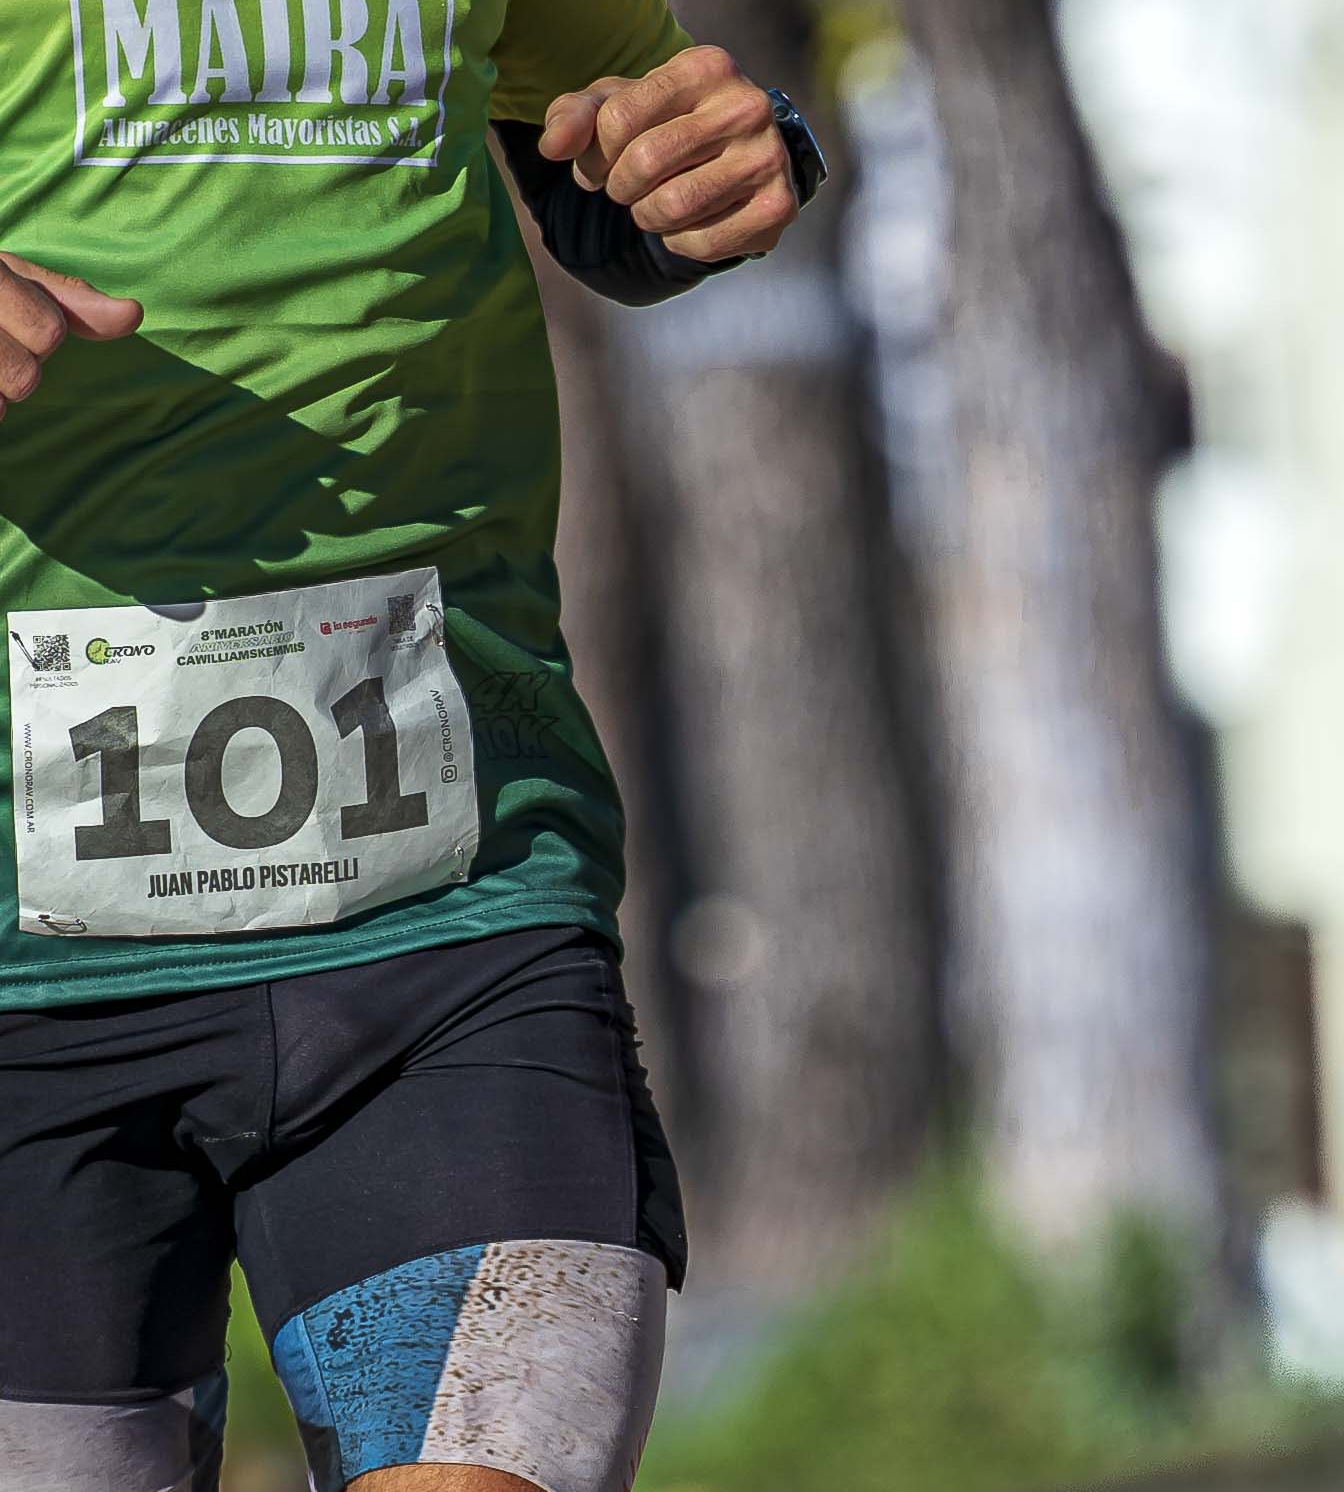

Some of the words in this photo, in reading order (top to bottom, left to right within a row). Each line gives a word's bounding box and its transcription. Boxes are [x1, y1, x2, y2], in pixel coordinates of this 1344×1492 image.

[99, 116, 240, 148] Almacenes
[248, 113, 383, 150] Mayoristas
[389, 116, 423, 148] S.A.
[176, 642, 306, 666] CAWILLIAMSKEMMIS
[429, 689, 454, 764] @CRONORAV
[23, 722, 36, 834] WWW.CRONORAV.COM.AR
[68, 676, 429, 861] 101
[147, 871, 193, 899] JUAN
[197, 866, 256, 894] PABLO
[259, 858, 359, 889] PISTARELLI
